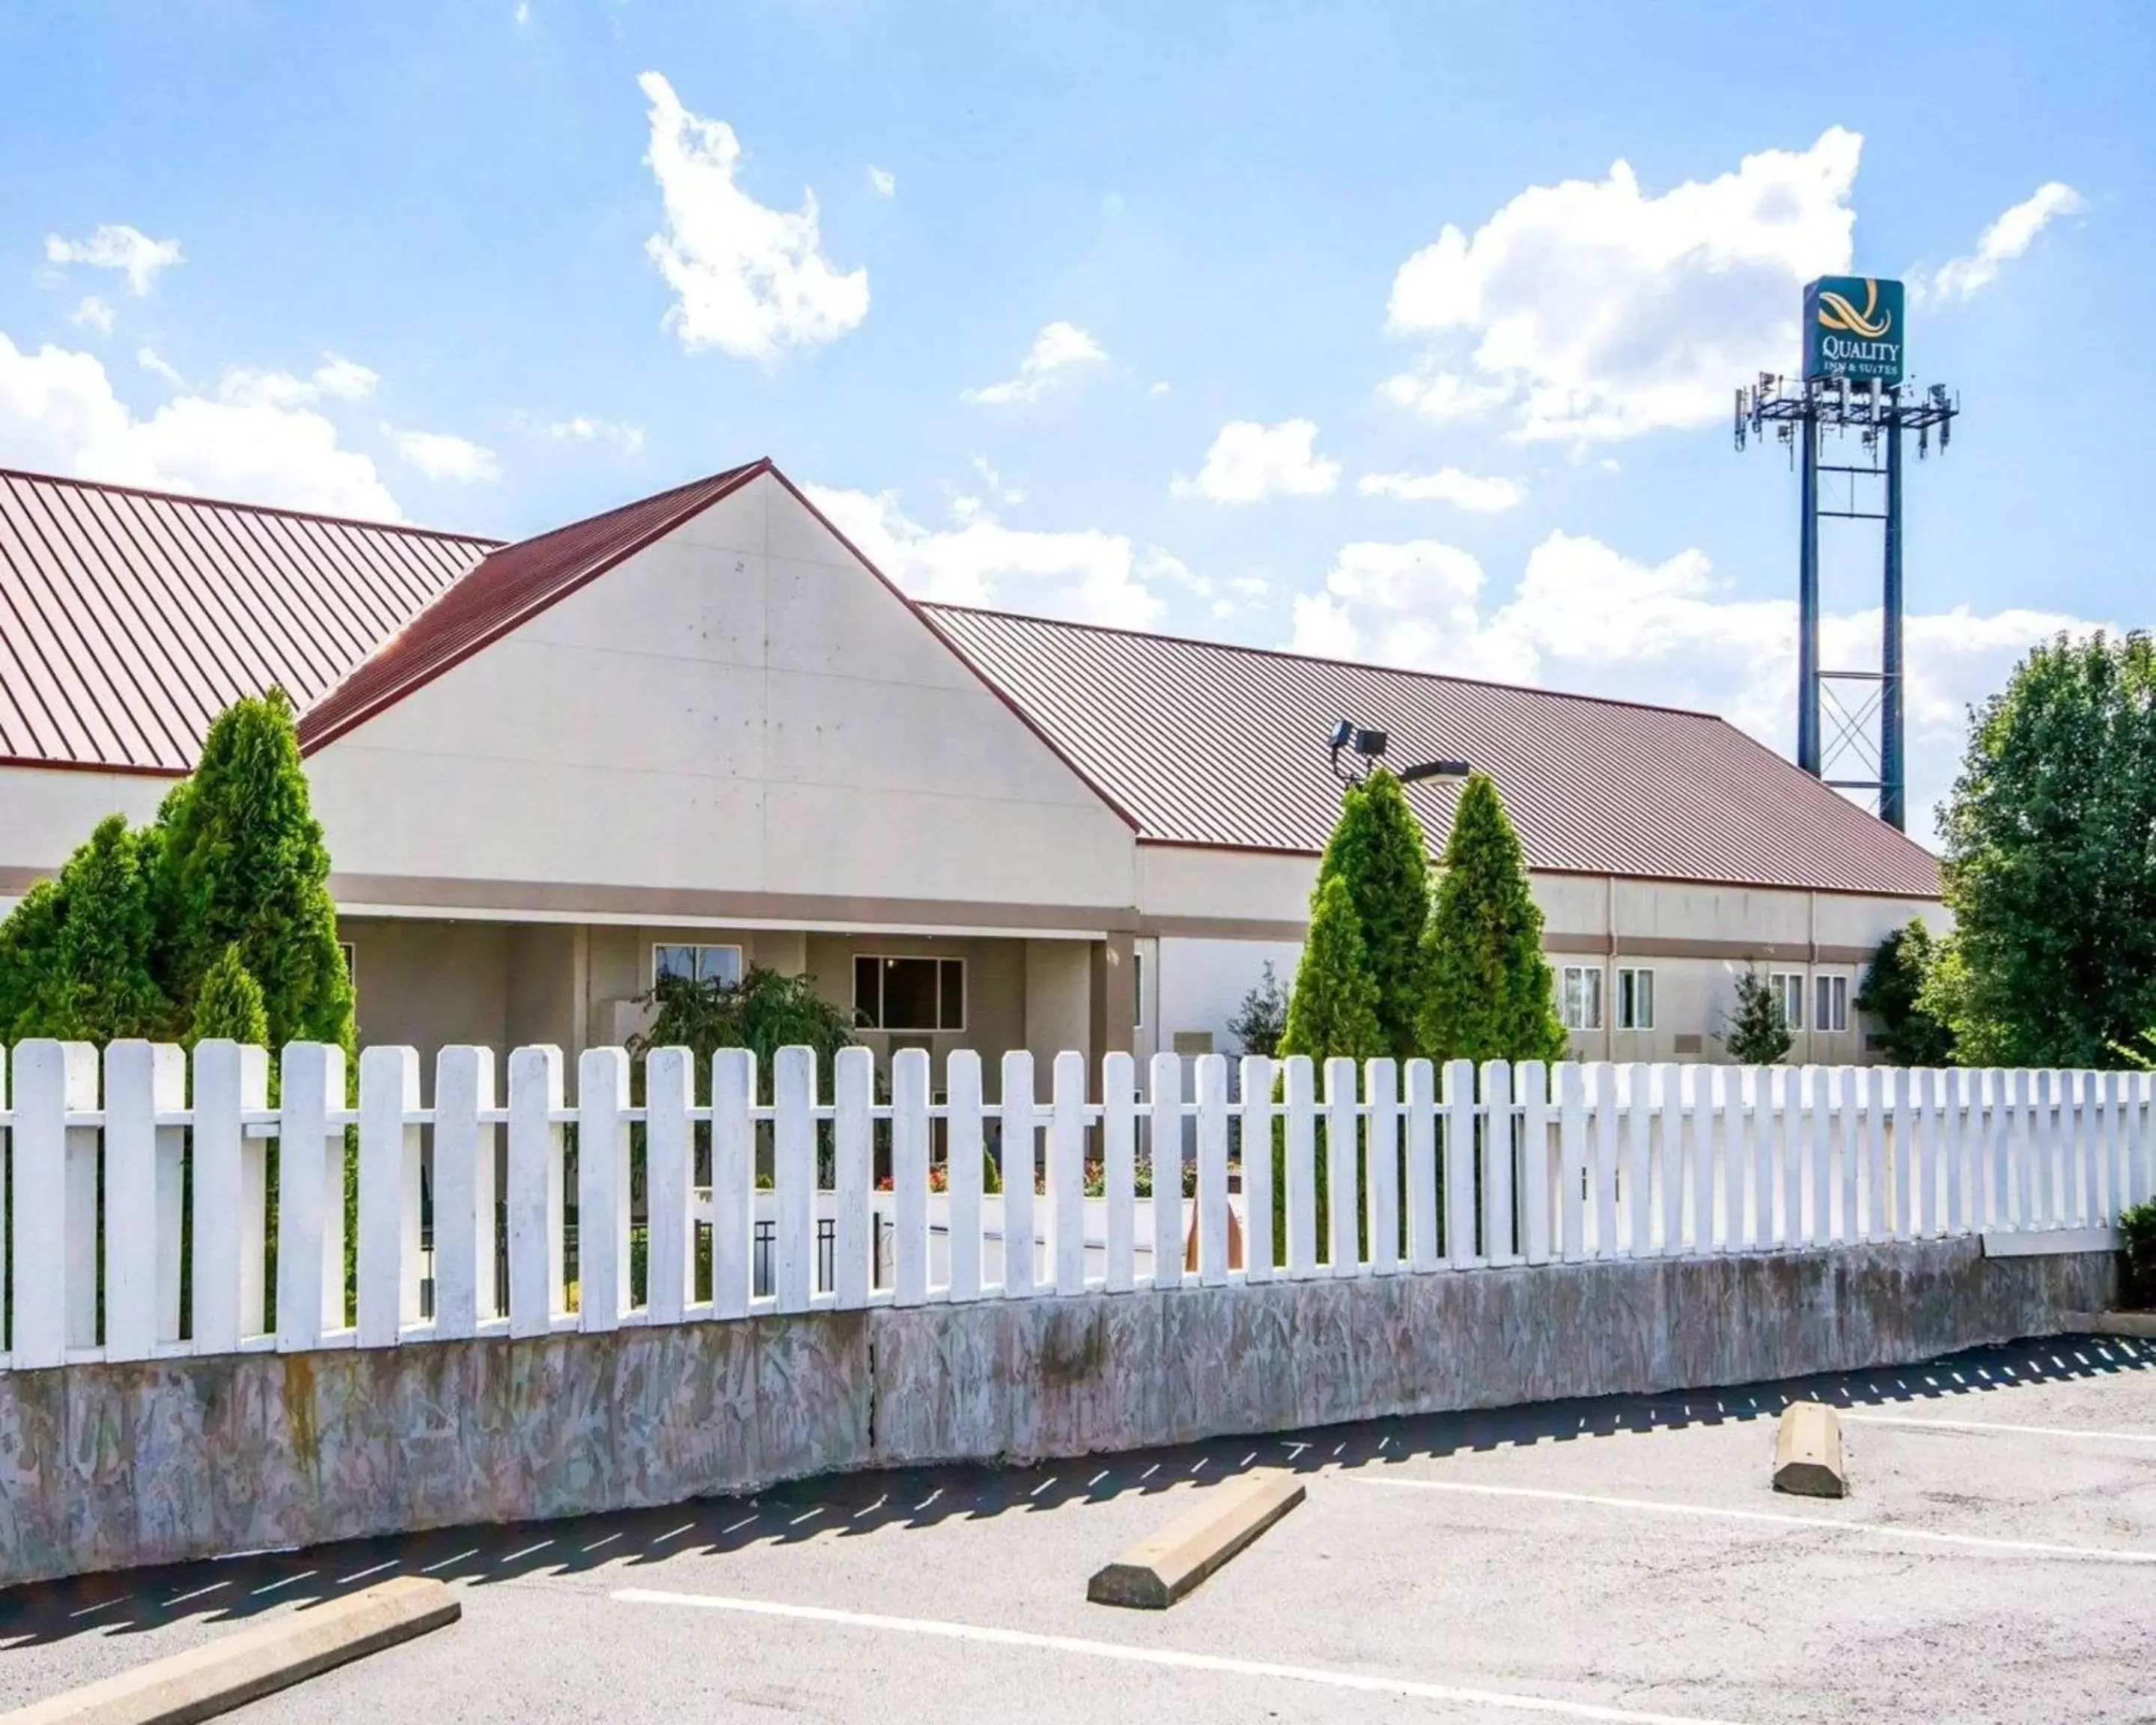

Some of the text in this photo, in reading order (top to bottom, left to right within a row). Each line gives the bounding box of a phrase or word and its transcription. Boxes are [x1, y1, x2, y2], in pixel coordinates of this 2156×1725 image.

[1823, 335, 1899, 361] QUALITY
[1824, 361, 1898, 374] INN & SUITES
